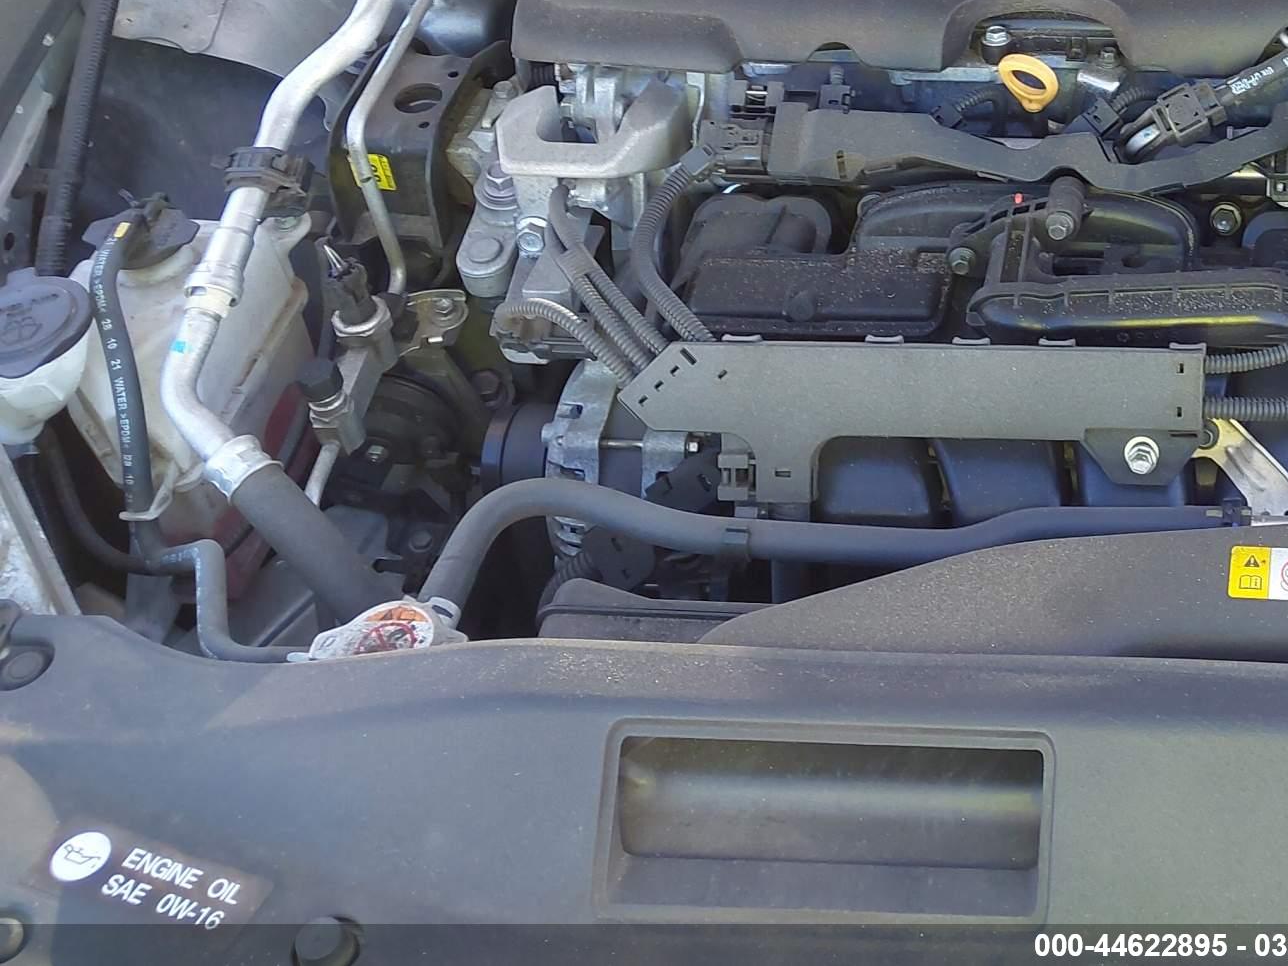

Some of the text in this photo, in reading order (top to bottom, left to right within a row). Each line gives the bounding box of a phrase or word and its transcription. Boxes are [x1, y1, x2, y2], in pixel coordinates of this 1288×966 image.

[94, 249, 111, 276] WATER
[105, 337, 118, 350] 10
[110, 358, 122, 371] 21
[113, 376, 128, 411] WATER
[121, 847, 241, 905] ENGINE OIL
[101, 874, 225, 930] SAE 0W-16
